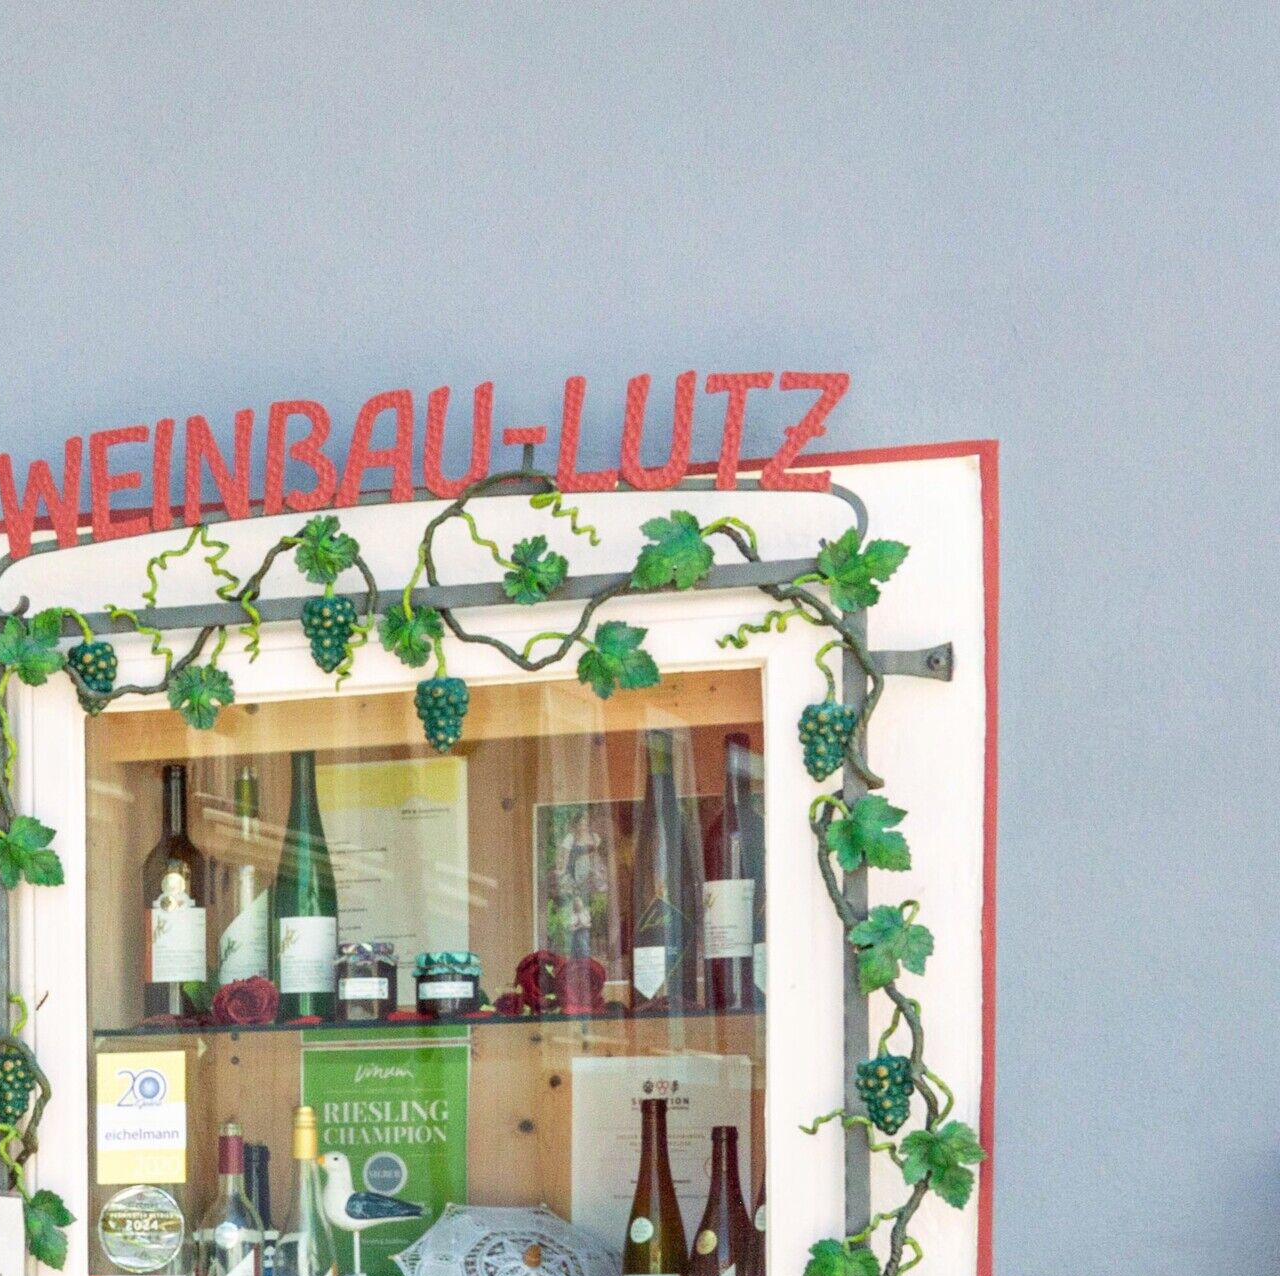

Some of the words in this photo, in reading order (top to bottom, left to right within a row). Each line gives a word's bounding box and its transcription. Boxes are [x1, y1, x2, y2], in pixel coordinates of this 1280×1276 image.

[323, 1099, 449, 1124] RIESLING
[104, 1127, 180, 1142] eichelmann
[323, 1125, 447, 1146] CHAMPION
